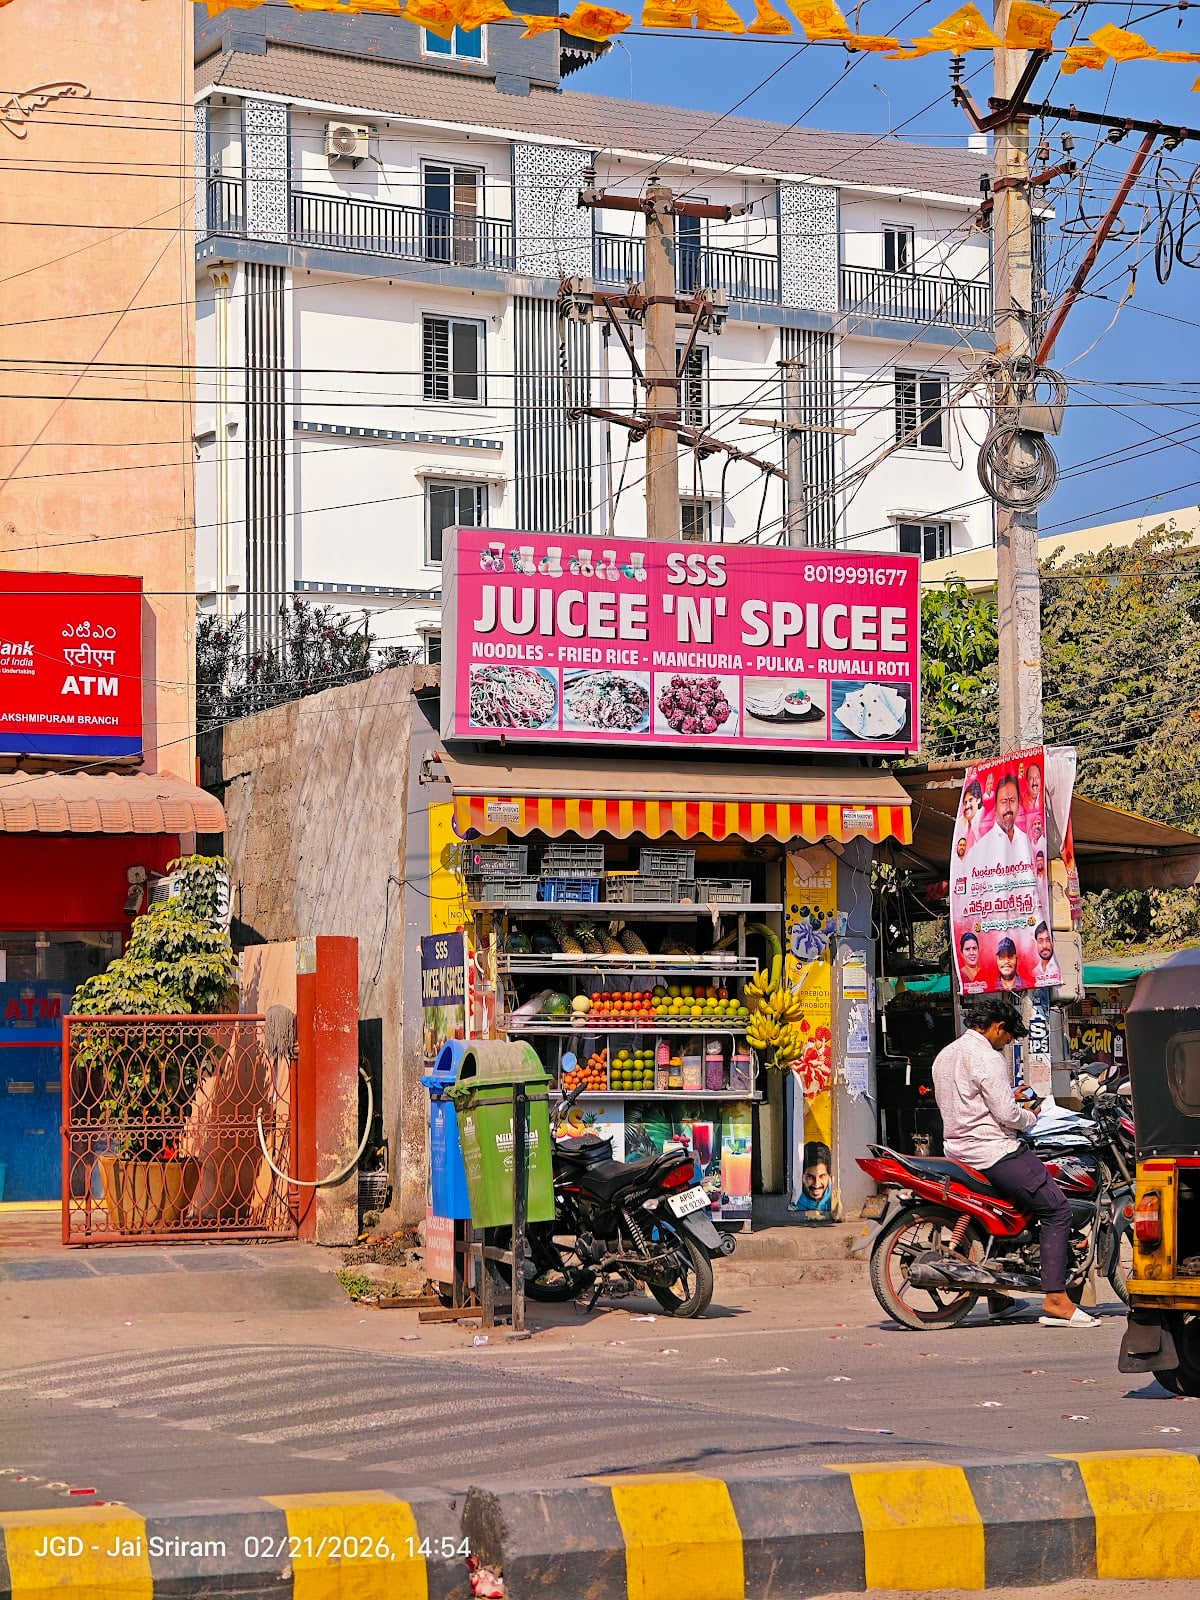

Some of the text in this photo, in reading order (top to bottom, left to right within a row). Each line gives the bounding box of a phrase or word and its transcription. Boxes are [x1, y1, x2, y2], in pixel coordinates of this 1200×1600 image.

[667, 553, 726, 586] SSS
[804, 565, 907, 586] 8019991677
[474, 585, 908, 651] JUICEE 'N' SPICEE
[0, 640, 35, 656] ank
[63, 643, 116, 667] एटीएम
[1, 657, 33, 667] of India
[472, 642, 543, 660] NOODLES
[559, 647, 603, 664] FRIED
[609, 649, 639, 665] RICE
[653, 651, 743, 670] MANCHURIA
[757, 656, 805, 673] PULKA
[818, 659, 873, 675] RUMALI
[878, 661, 910, 677] ROTI
[61, 675, 119, 697] ATM
[78, 715, 119, 726] BRANCH
[435, 940, 448, 959] SSS
[4, 998, 61, 1019] ATM
[1082, 1027, 1112, 1054] Stall
